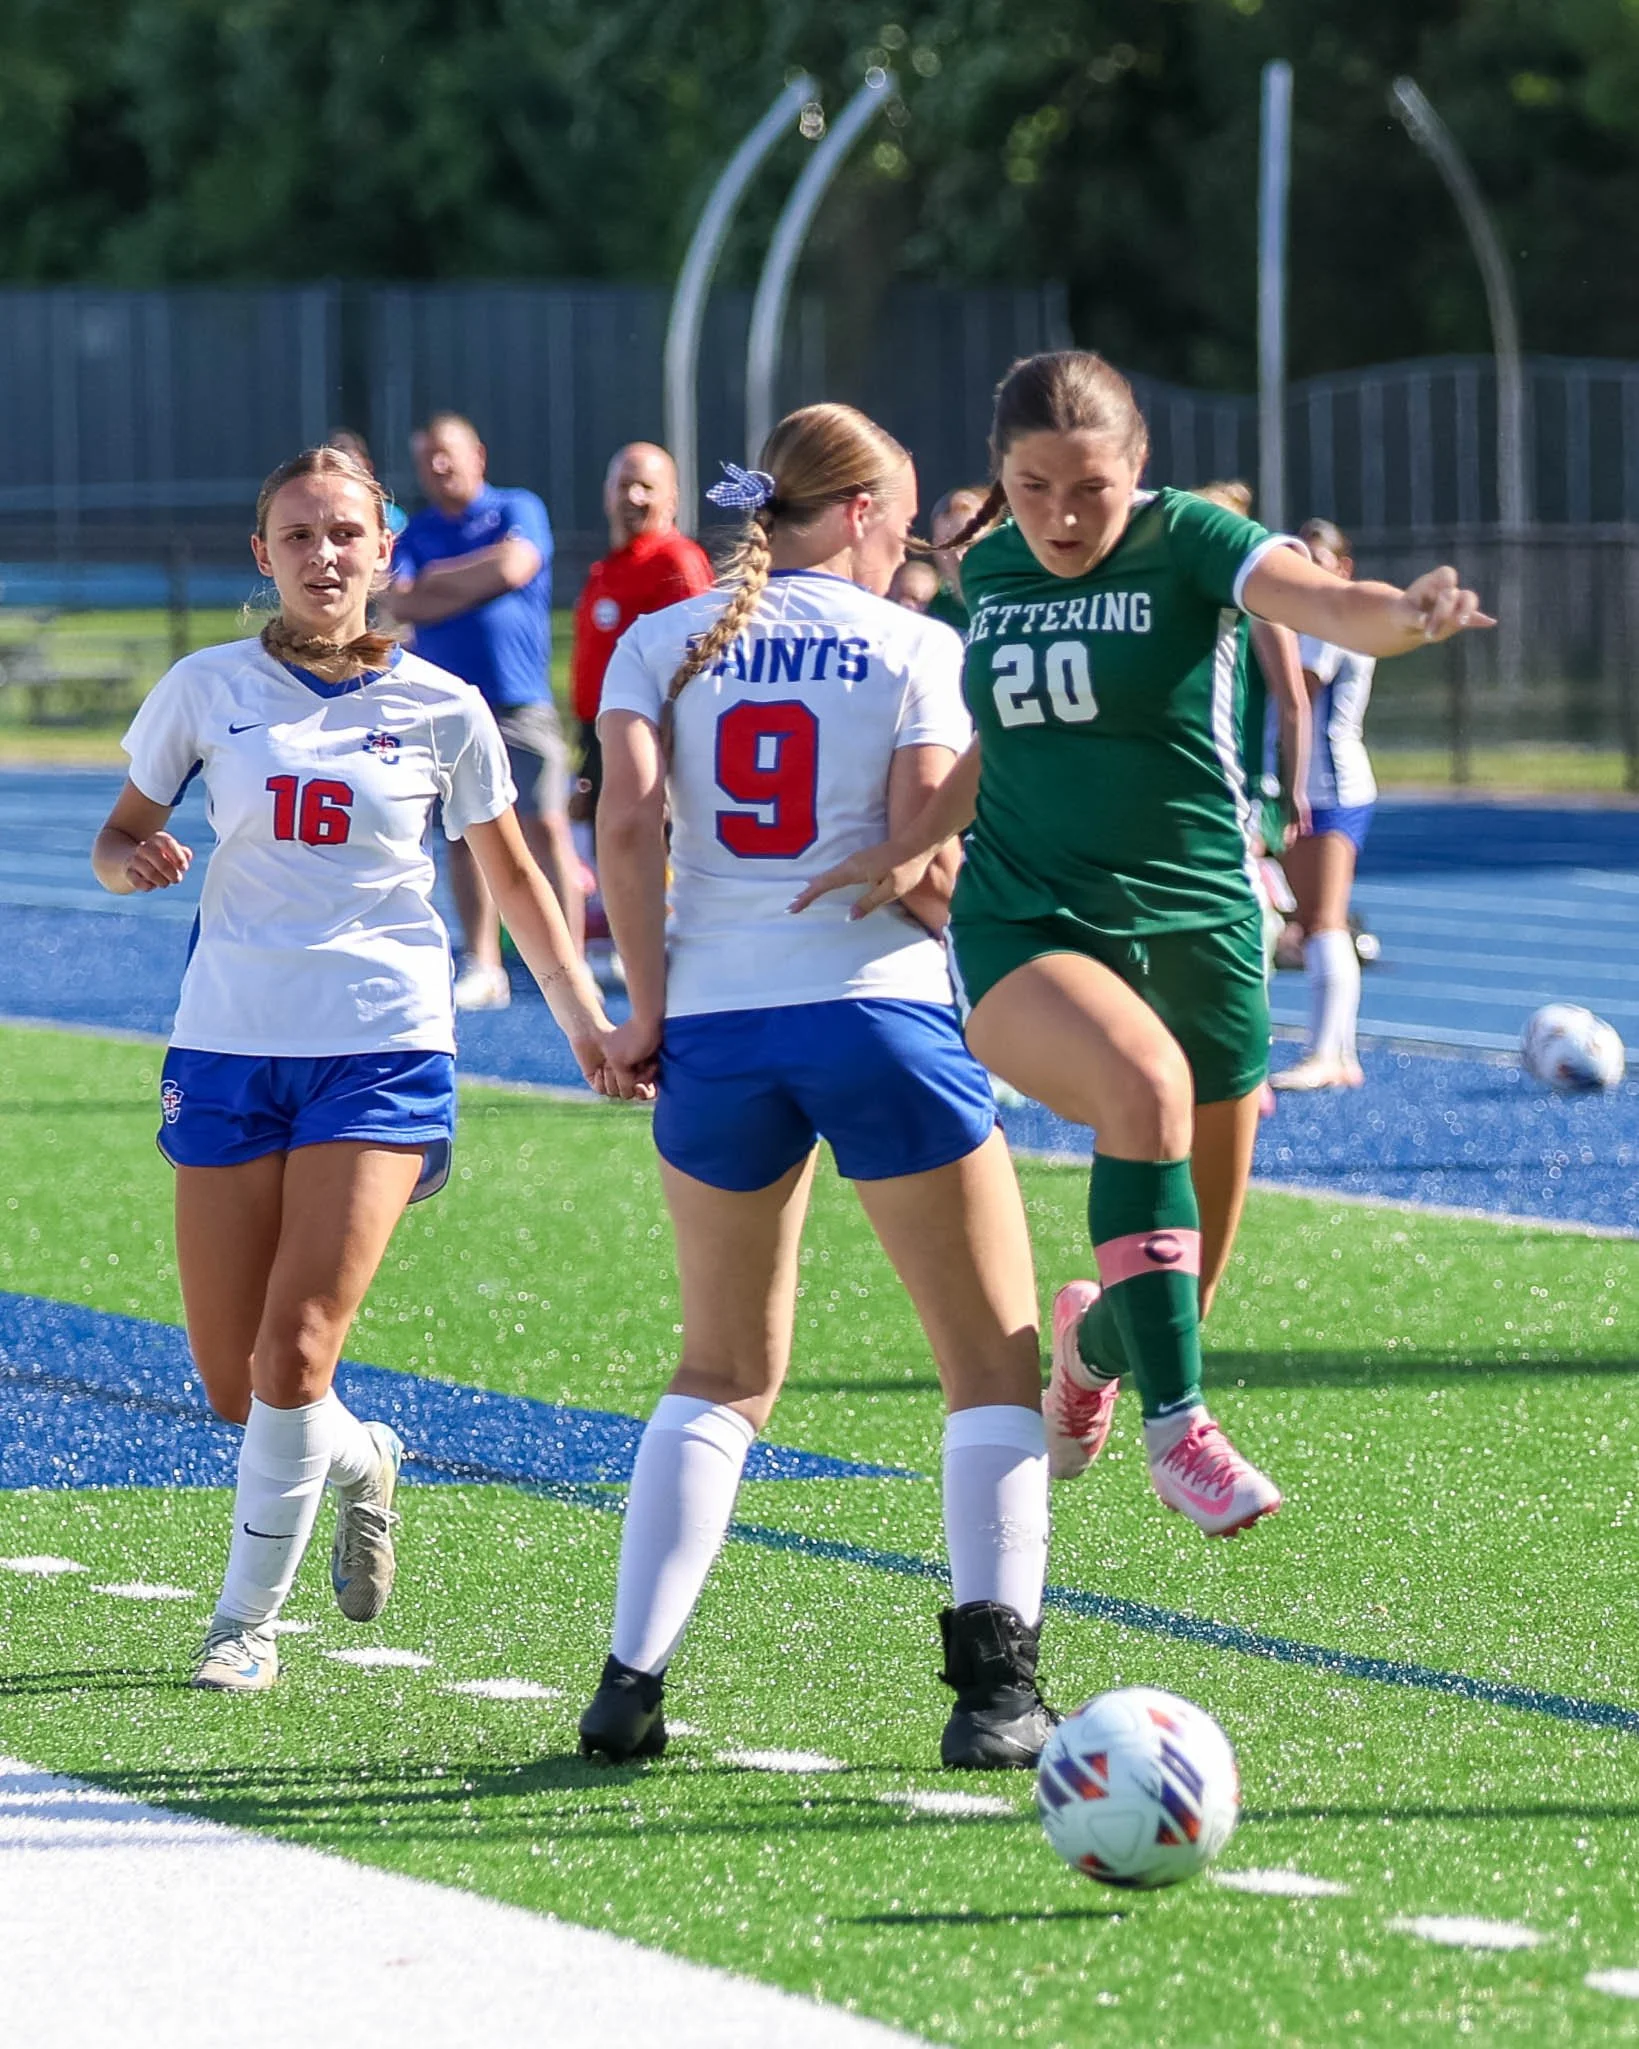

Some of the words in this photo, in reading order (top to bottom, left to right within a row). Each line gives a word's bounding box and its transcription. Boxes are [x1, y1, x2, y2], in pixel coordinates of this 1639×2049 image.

[685, 632, 870, 684] AINTS
[992, 640, 1099, 728] 20
[265, 774, 354, 846] 16
[714, 698, 820, 860] 9
